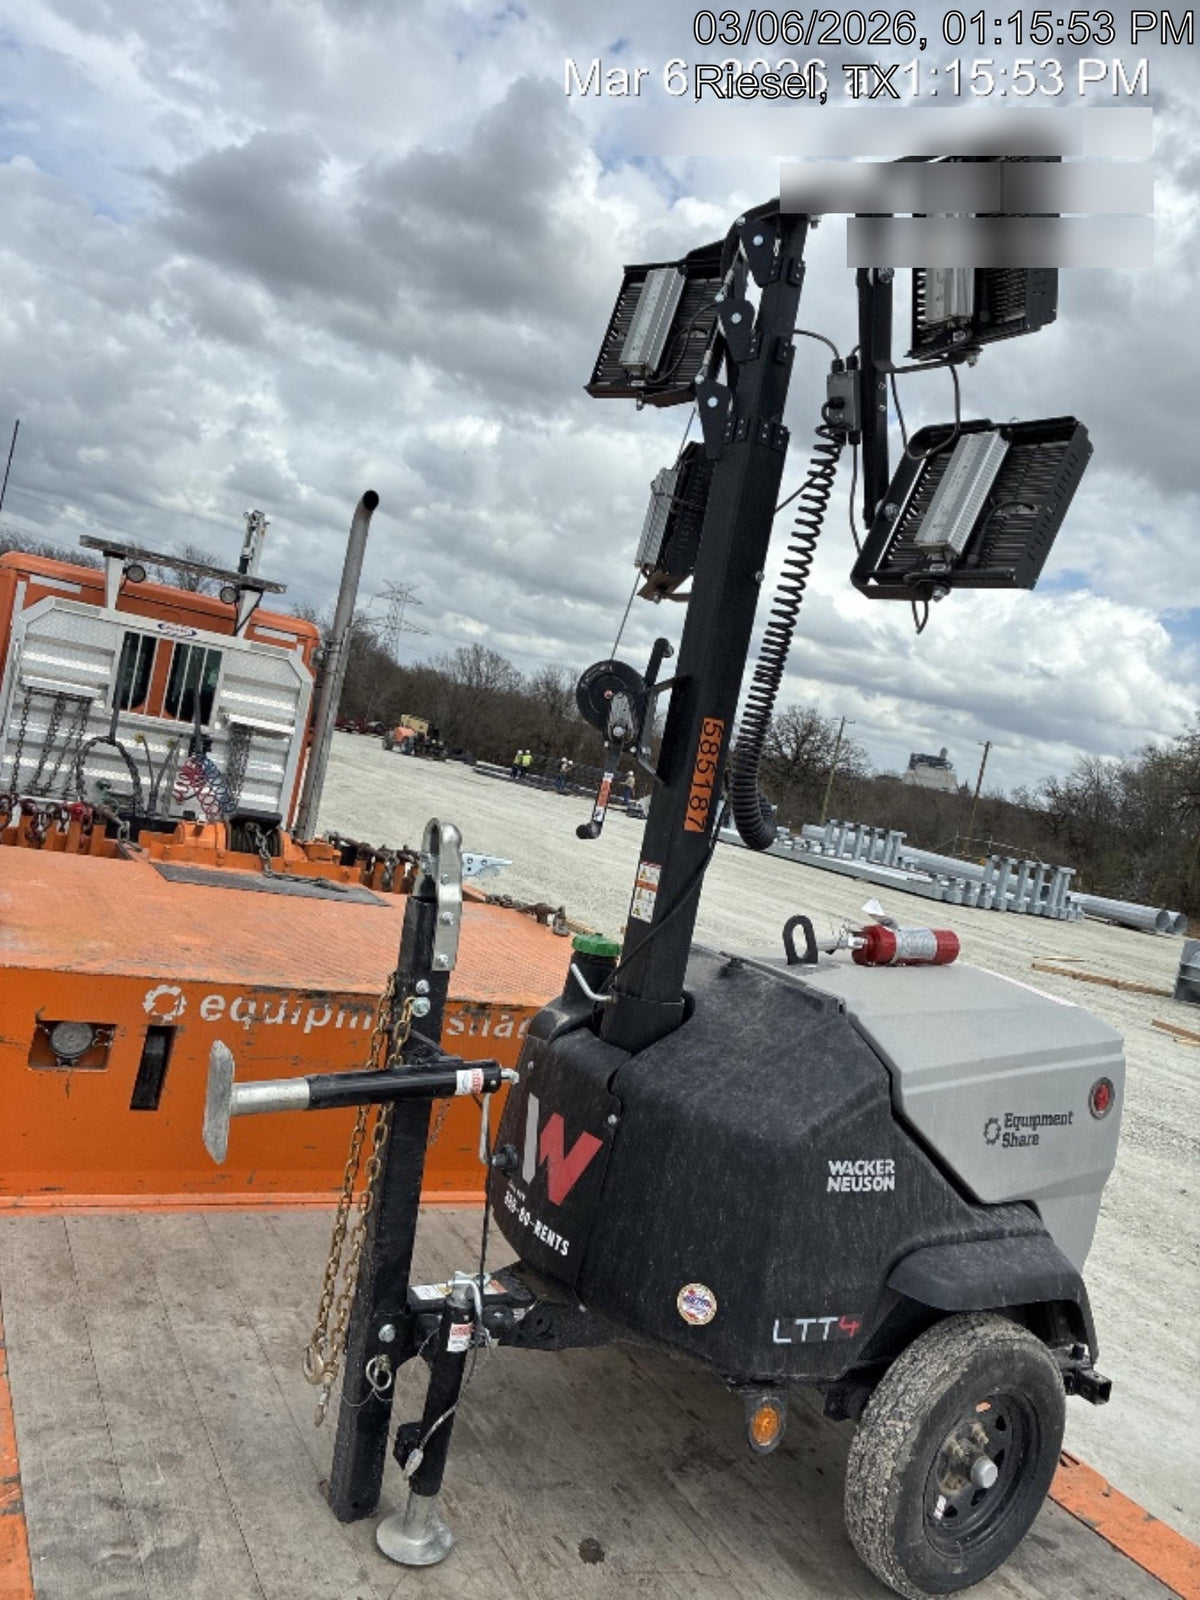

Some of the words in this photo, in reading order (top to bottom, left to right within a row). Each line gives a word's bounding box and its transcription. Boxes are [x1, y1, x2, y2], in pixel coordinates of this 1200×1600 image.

[687, 720, 724, 830] 585187
[1004, 1111, 1074, 1131] Equipment
[1002, 1132, 1039, 1148] Share
[827, 1159, 896, 1176] WACKER
[826, 1175, 896, 1192] NEUSON
[772, 1315, 861, 1343] LTT4
